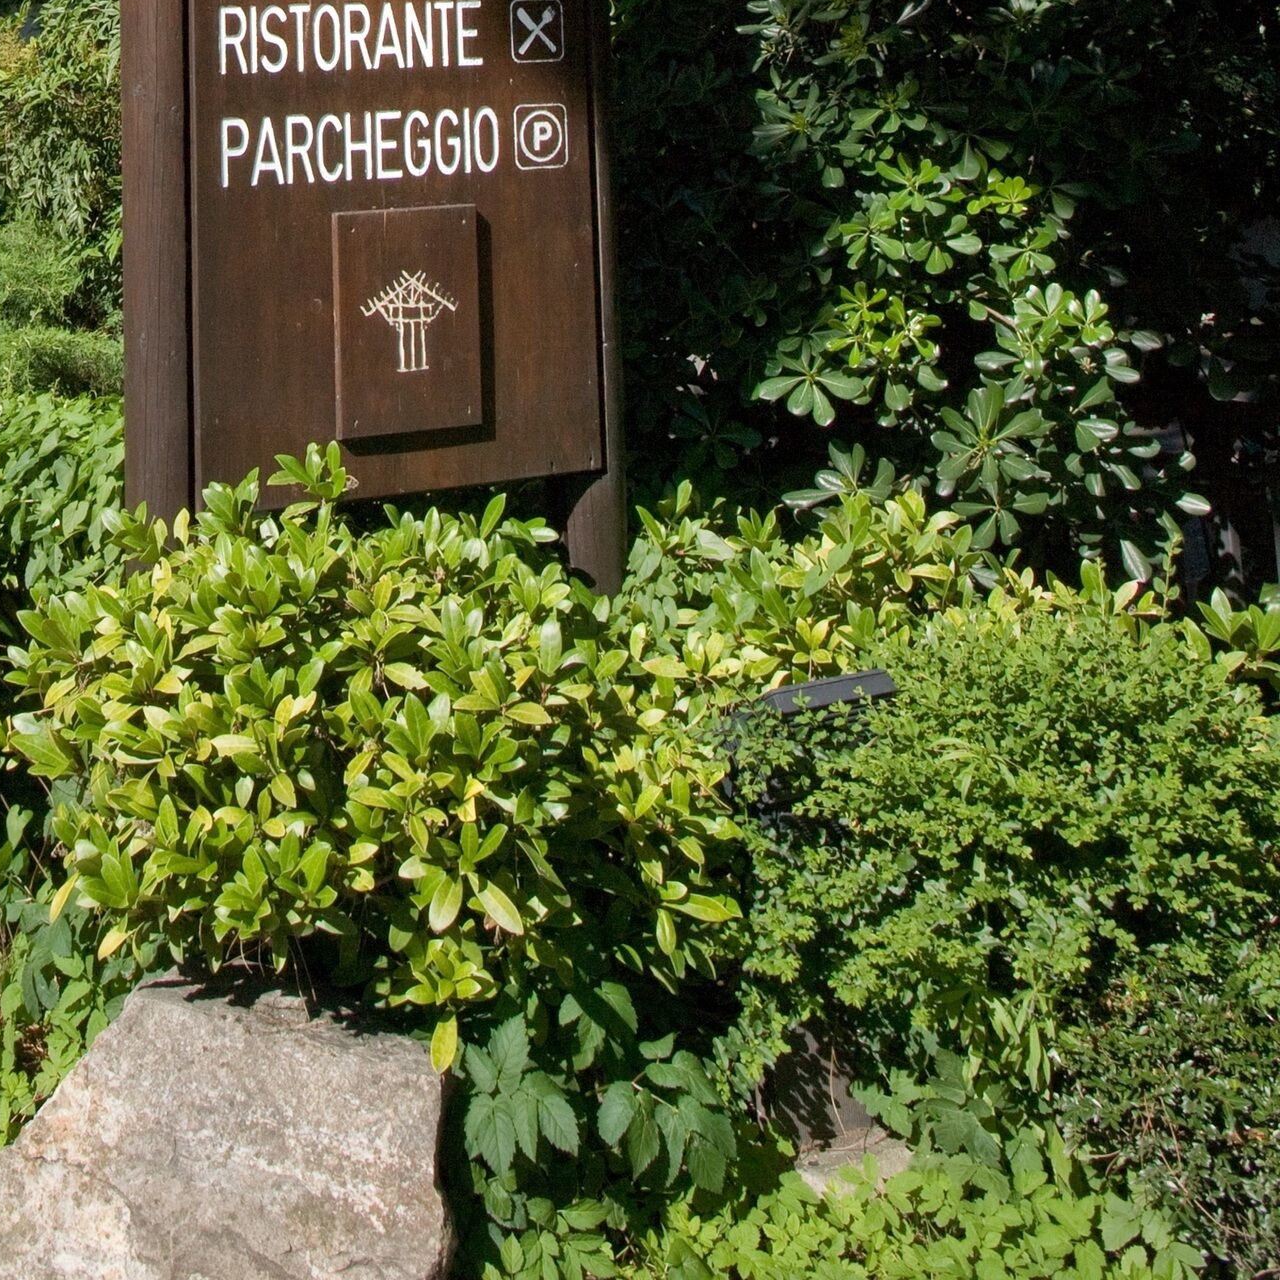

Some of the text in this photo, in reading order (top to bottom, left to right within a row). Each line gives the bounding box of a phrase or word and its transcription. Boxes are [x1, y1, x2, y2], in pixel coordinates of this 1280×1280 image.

[219, 0, 483, 75] RISTORANTE
[220, 106, 500, 188] PARCHEGGIO
[532, 126, 552, 151] P
